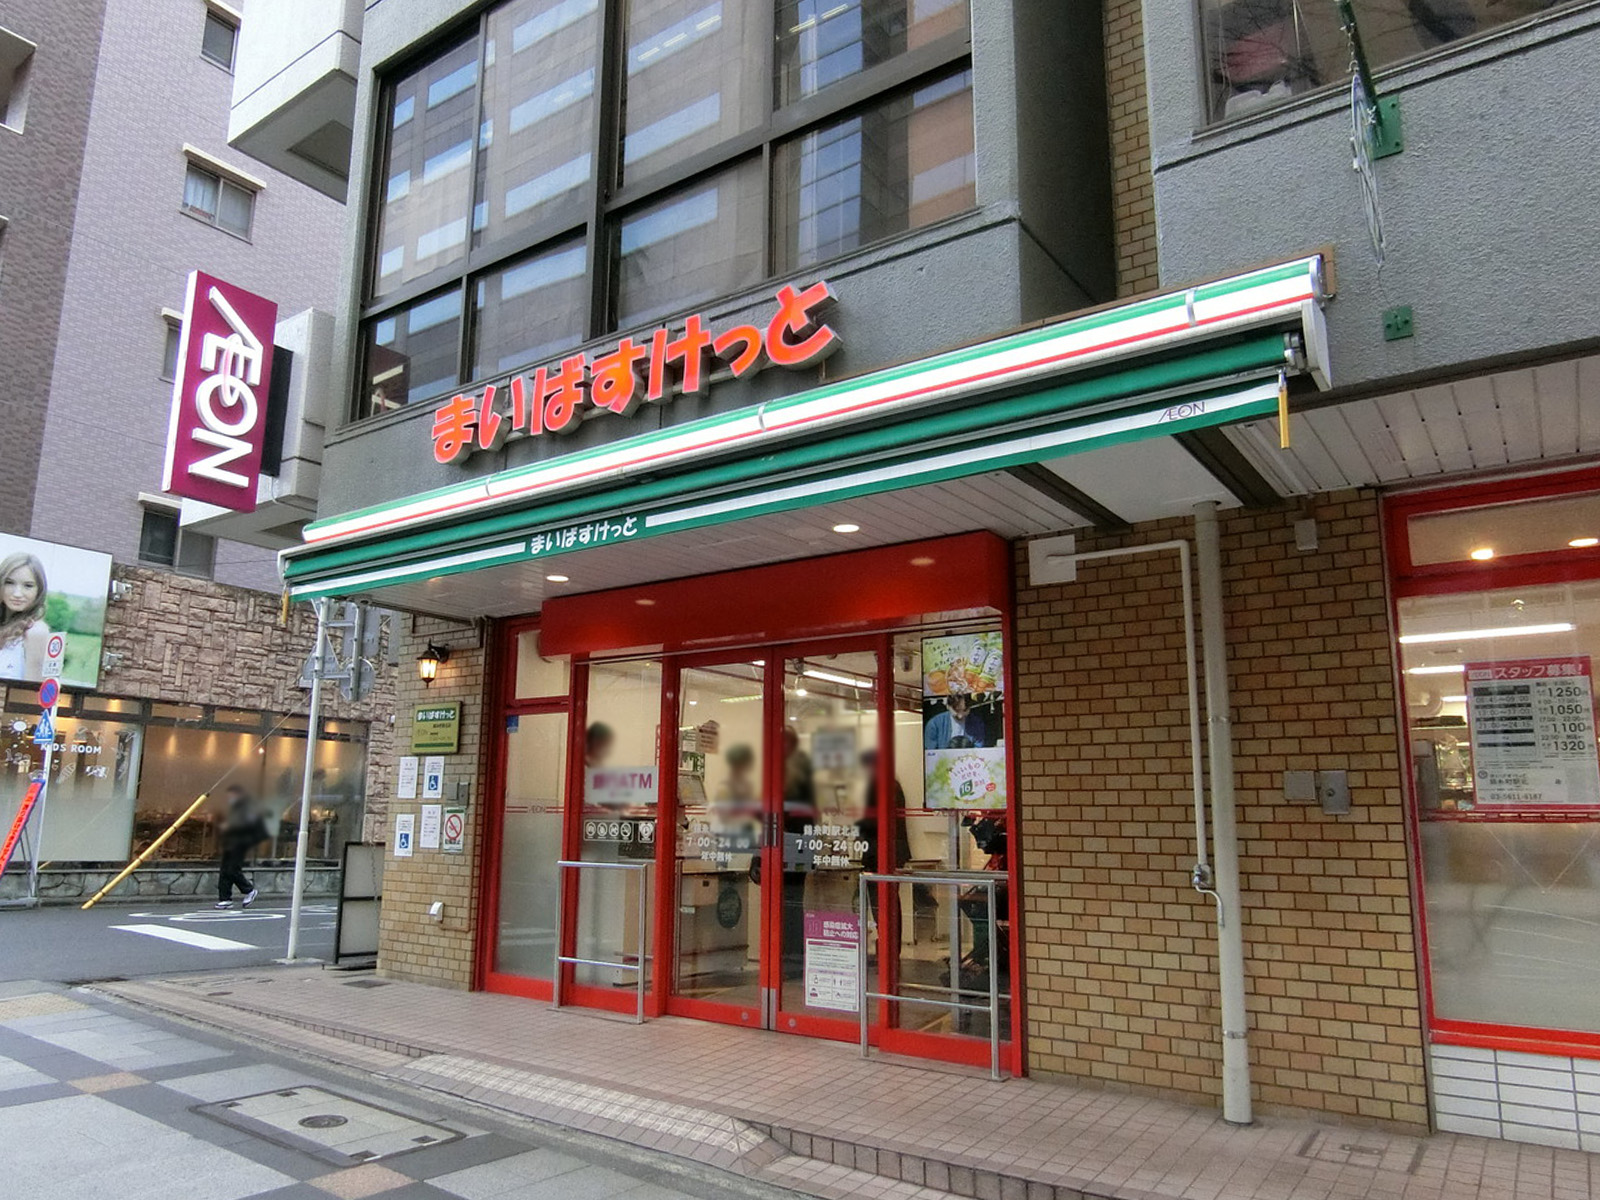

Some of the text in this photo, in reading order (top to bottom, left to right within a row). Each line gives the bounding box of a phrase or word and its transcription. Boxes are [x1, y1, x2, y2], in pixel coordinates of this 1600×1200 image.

[431, 280, 838, 464] まいばすけっと
[530, 516, 638, 555] まいばすけっと
[41, 743, 102, 754] KDS ROOM
[813, 854, 850, 867] 年中無休
